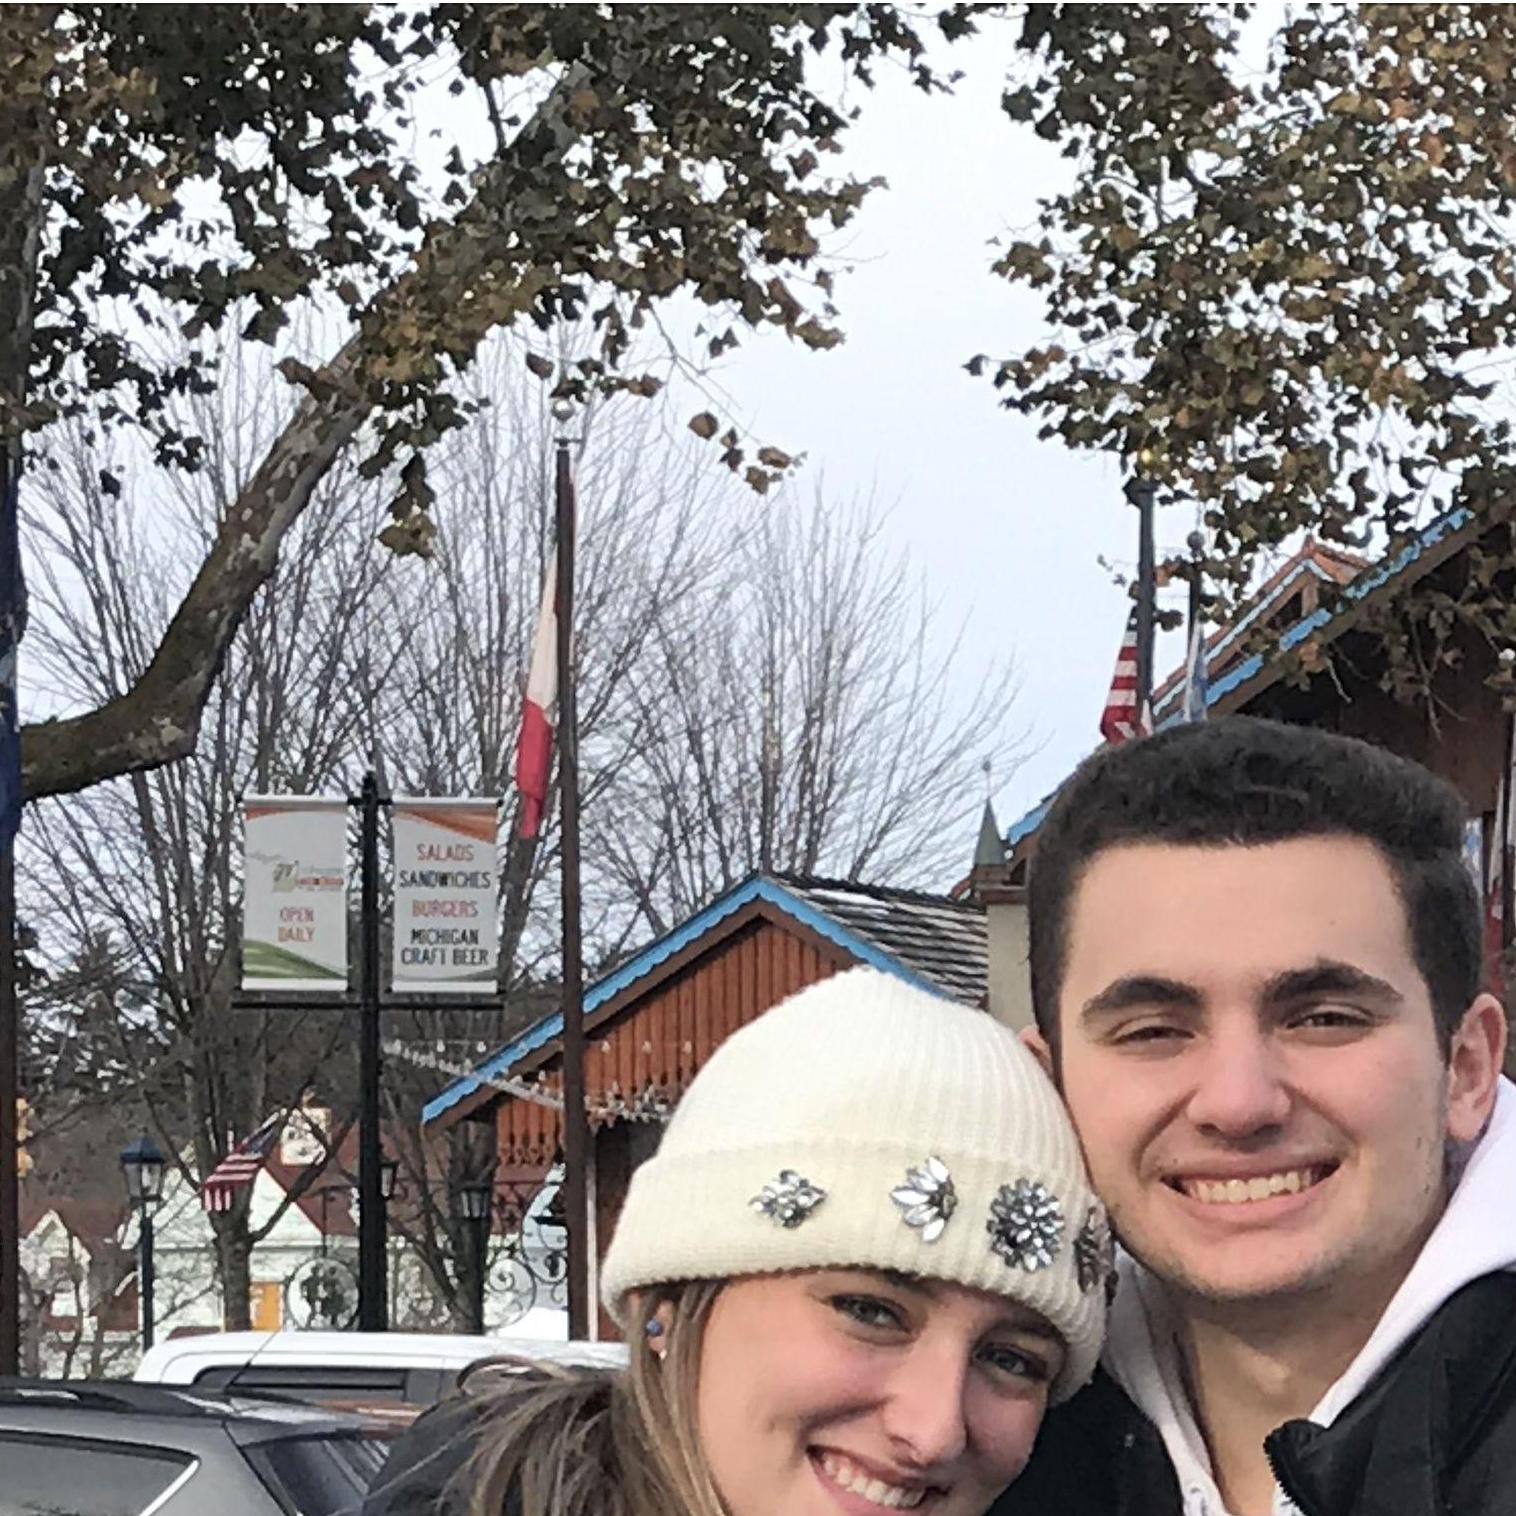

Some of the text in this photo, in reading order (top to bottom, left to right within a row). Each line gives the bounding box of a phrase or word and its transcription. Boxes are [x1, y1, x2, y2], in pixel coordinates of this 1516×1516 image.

[416, 844, 475, 862] SALADS
[400, 871, 491, 889] SANDWICHES
[279, 906, 315, 923] OPEN
[411, 900, 479, 918] BURGERS
[277, 926, 316, 943] DAILY
[410, 928, 479, 946] MICHIGAN
[401, 948, 489, 966] CRAFT BEER
